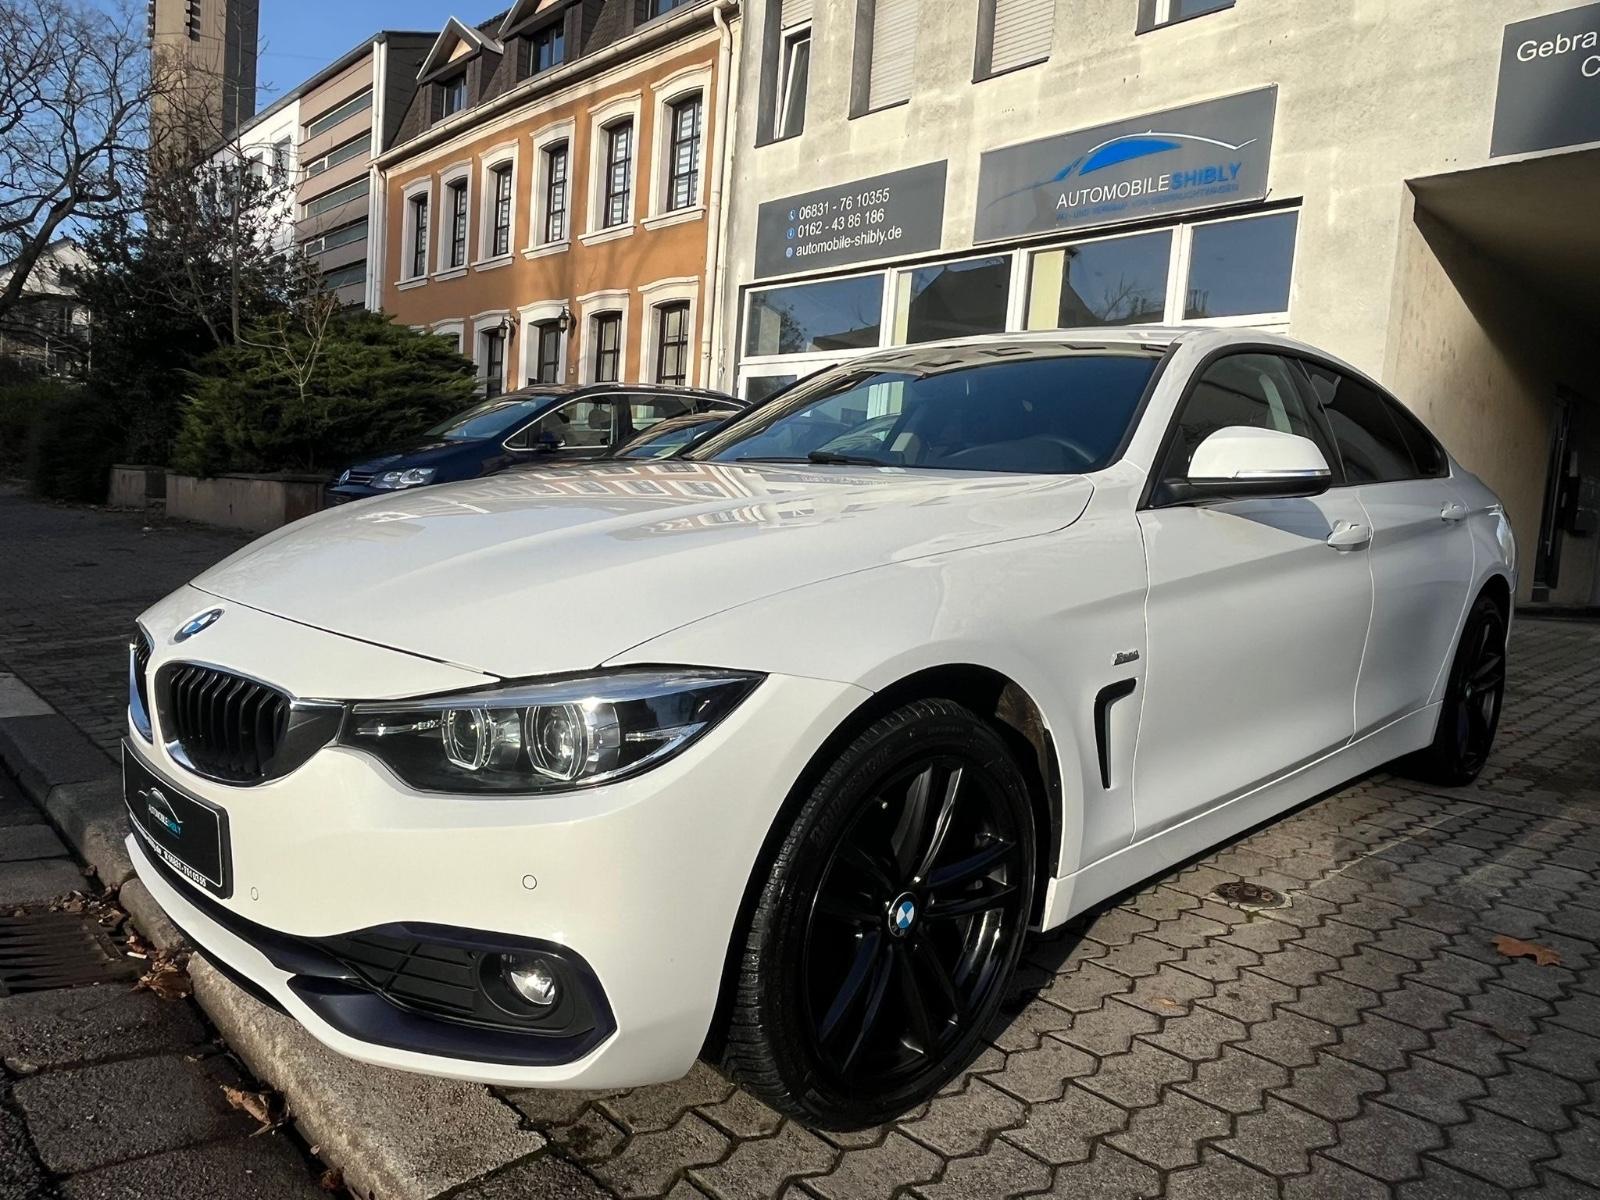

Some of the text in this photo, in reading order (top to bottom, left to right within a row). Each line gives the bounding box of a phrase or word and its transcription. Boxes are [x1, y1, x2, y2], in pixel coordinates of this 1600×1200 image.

[799, 202, 829, 220] 06831
[840, 196, 853, 212] 76
[856, 187, 890, 208] 10355
[797, 222, 822, 238] 0162
[831, 216, 845, 231] 43
[848, 213, 861, 227] 86
[865, 208, 885, 224] 186
[795, 225, 903, 257] automobile-shibly.de
